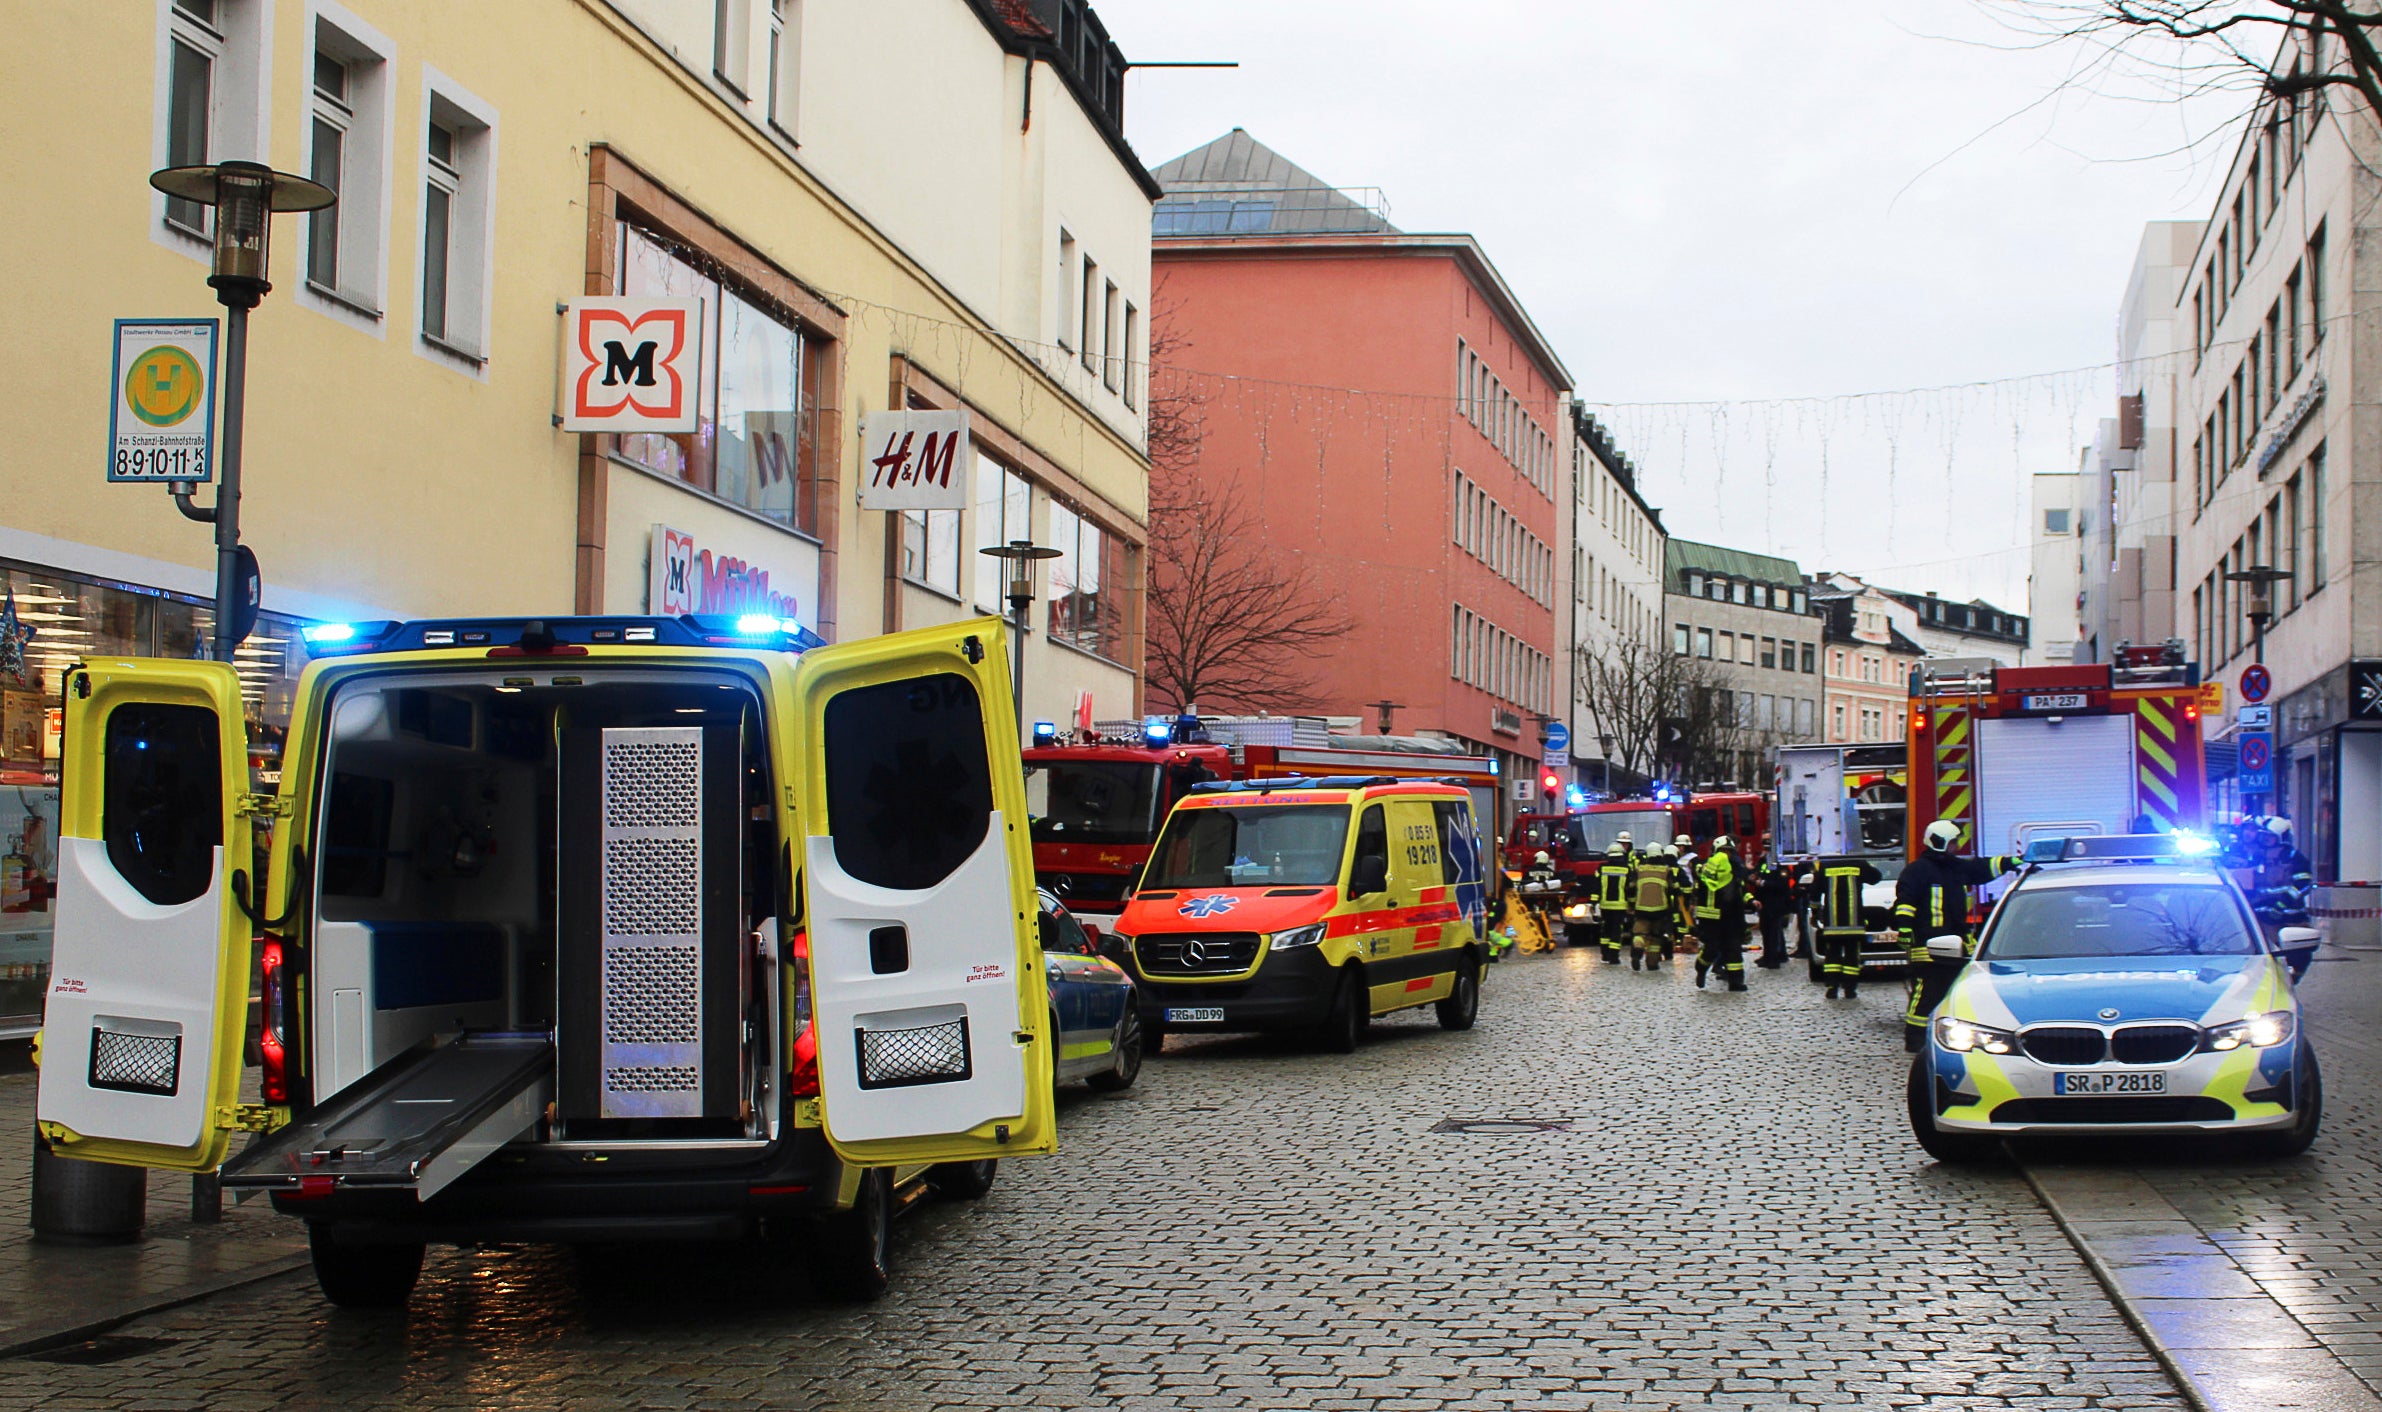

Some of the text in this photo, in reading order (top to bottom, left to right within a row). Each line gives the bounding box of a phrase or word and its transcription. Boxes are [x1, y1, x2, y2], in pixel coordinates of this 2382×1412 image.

[602, 341, 659, 386] M
[118, 436, 129, 446] Am
[872, 430, 959, 489] H&M
[2241, 773, 2269, 787] TAXI
[2030, 971, 2197, 983] POLIZEI
[2066, 1075, 2090, 1092] SR
[2117, 1074, 2164, 1092] 2818
